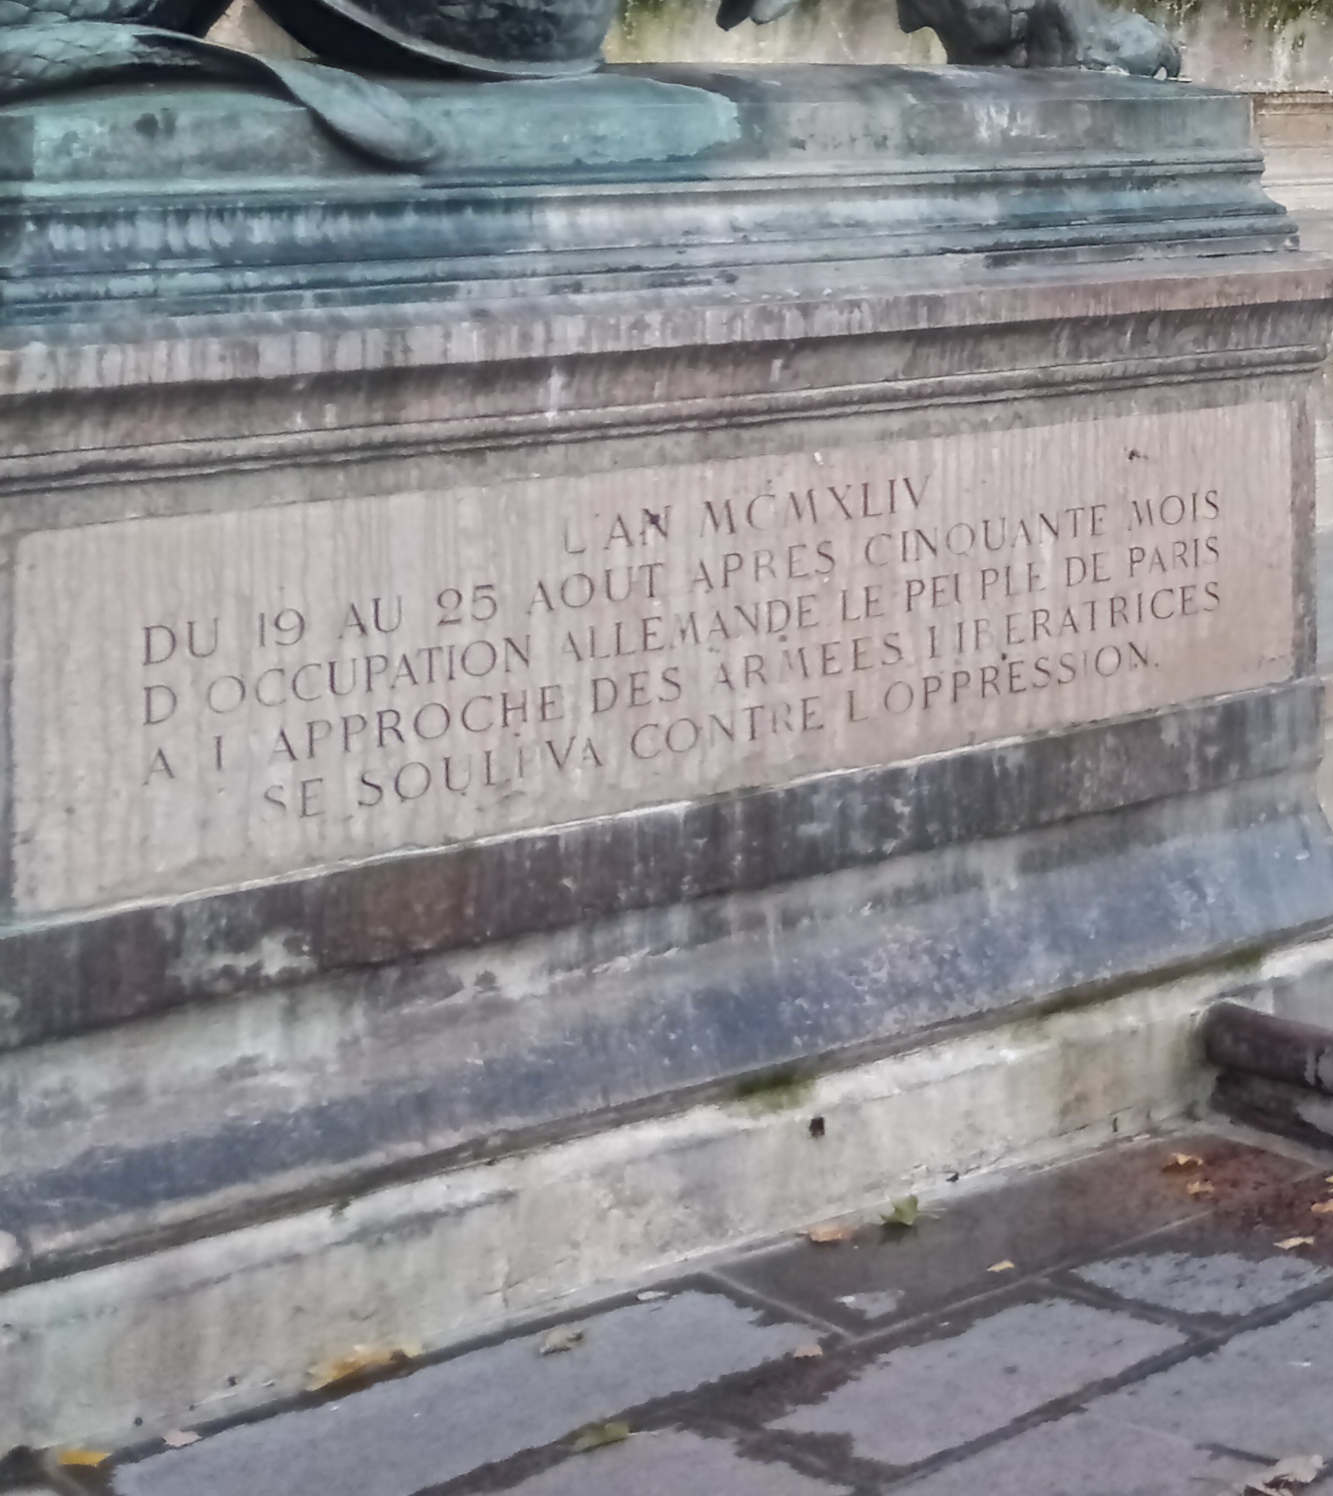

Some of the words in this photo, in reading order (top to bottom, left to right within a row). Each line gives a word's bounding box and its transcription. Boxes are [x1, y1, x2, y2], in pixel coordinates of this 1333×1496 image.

[700, 475, 931, 537] MCMXLIV
[143, 617, 220, 666] DU
[258, 608, 305, 647] 19
[337, 594, 403, 640] AU
[437, 584, 497, 626] 25
[526, 562, 664, 614] AOUT
[690, 540, 835, 593] APRES
[865, 504, 1107, 567] CINQUANTE
[1128, 490, 1219, 532] MOIS
[562, 594, 819, 661] ALLEMANDE
[841, 585, 884, 622] LE
[1065, 552, 1110, 587] DE
[1128, 536, 1219, 578] PARIS
[590, 666, 682, 714] DES
[711, 632, 903, 694] ARMEES
[264, 776, 323, 818] SE
[631, 696, 823, 759] CONTRE
